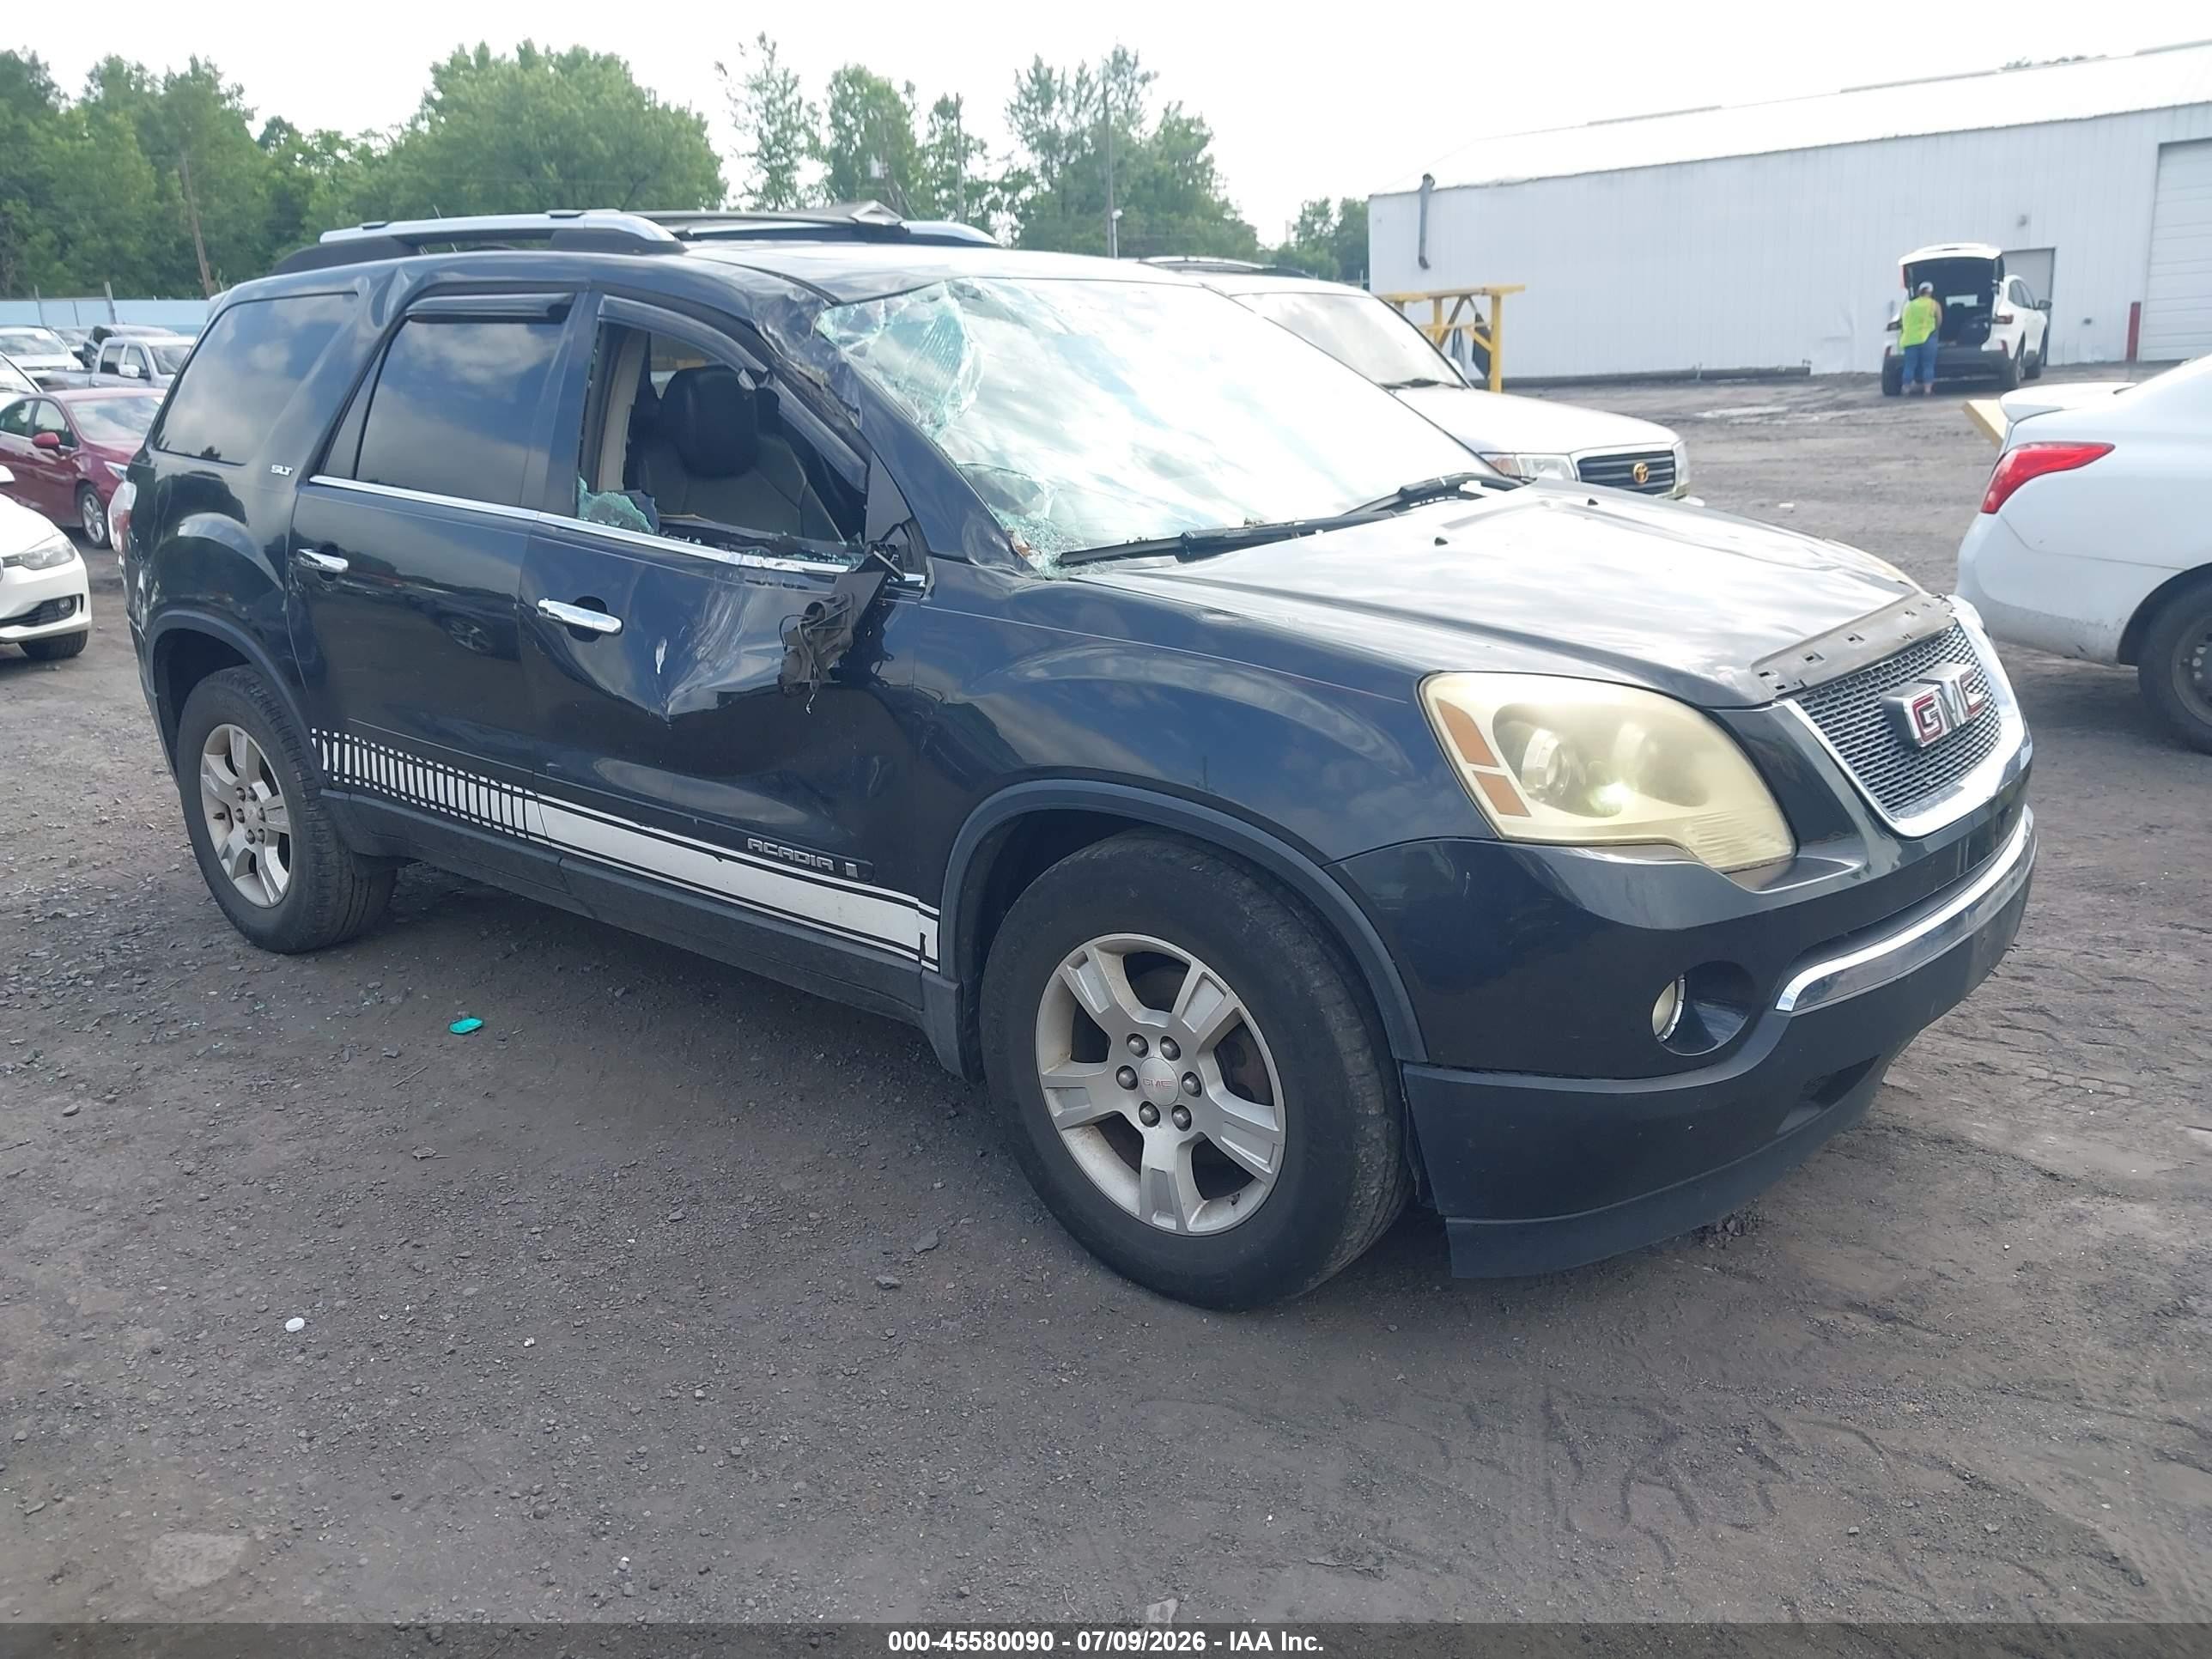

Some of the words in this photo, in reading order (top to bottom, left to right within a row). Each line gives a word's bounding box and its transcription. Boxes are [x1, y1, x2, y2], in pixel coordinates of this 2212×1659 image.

[270, 464, 293, 476] SLT
[1903, 668, 1989, 748] GMC
[747, 837, 835, 872] ACADIA
[1142, 1077, 1174, 1090] GMC
